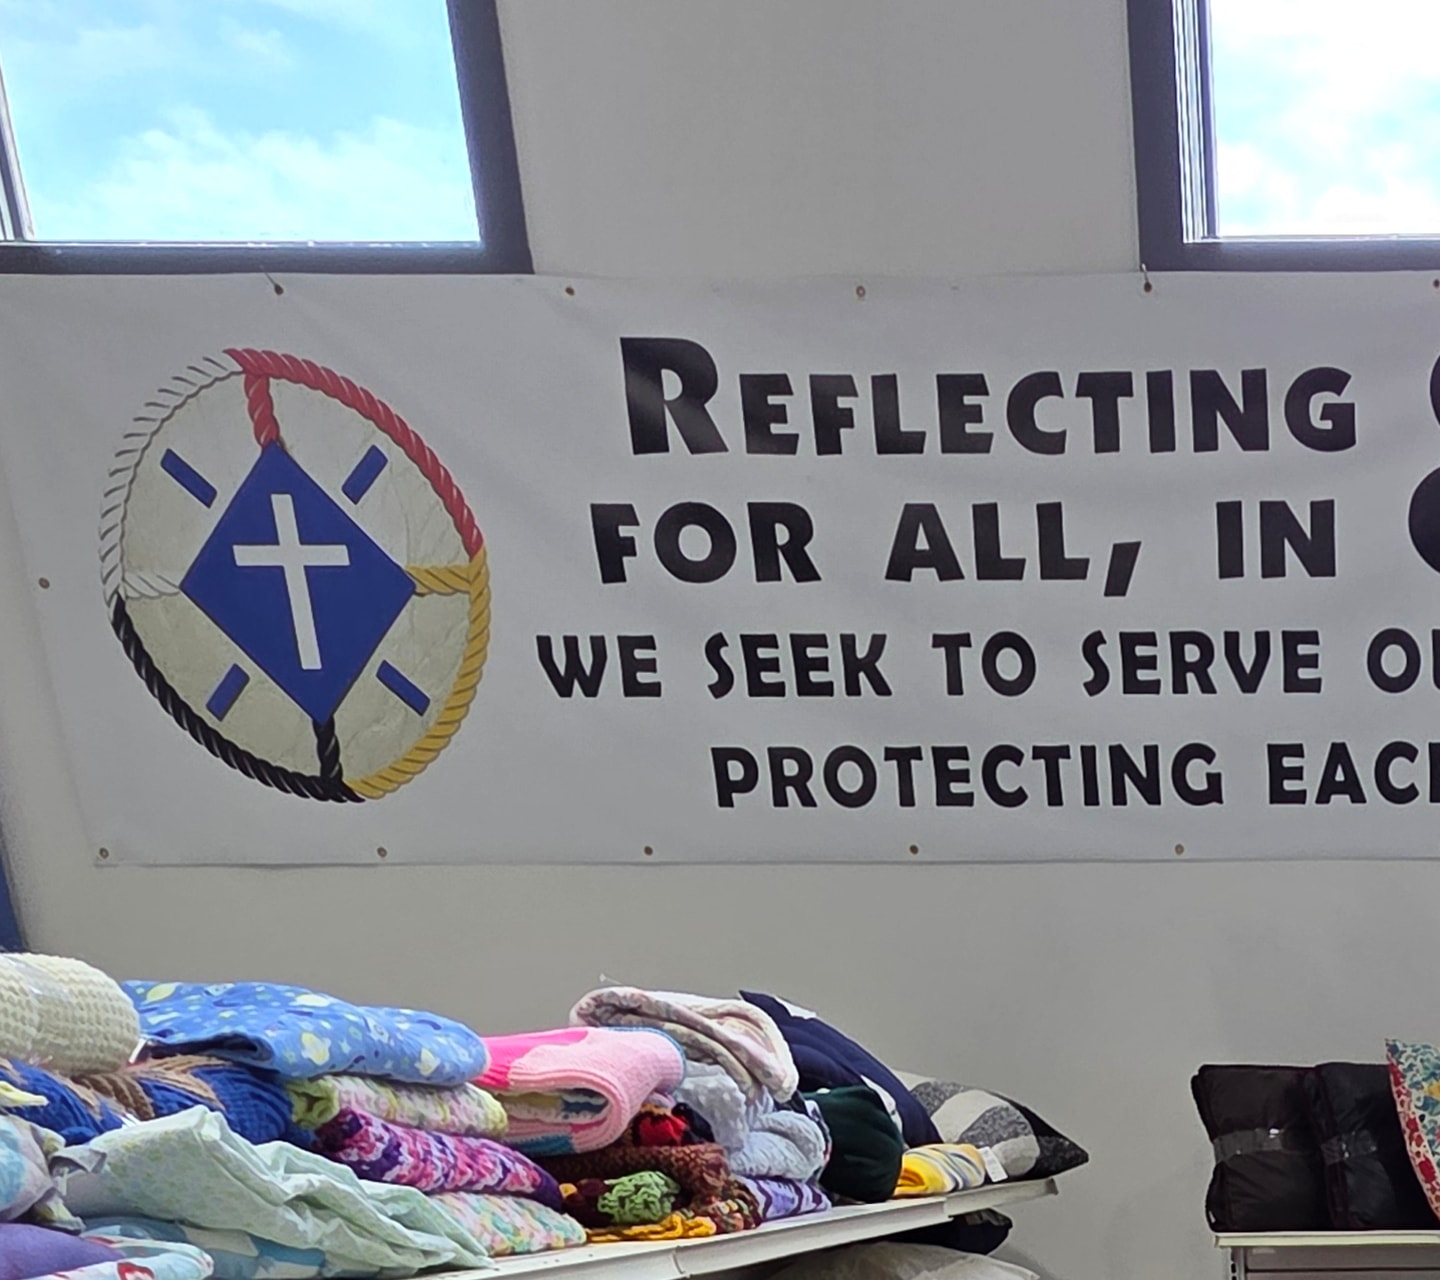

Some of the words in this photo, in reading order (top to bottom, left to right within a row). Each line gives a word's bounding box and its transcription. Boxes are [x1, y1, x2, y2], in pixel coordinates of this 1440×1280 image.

[619, 336, 1357, 457] REFLECTING
[590, 501, 822, 585] FOR
[884, 501, 1142, 598] ALL,
[1215, 498, 1337, 580] IN
[535, 634, 662, 699] WE
[704, 631, 893, 700] SEEK
[931, 630, 1037, 697] TO
[1081, 629, 1323, 697] SERVE
[710, 742, 1224, 809] PROTECTING
